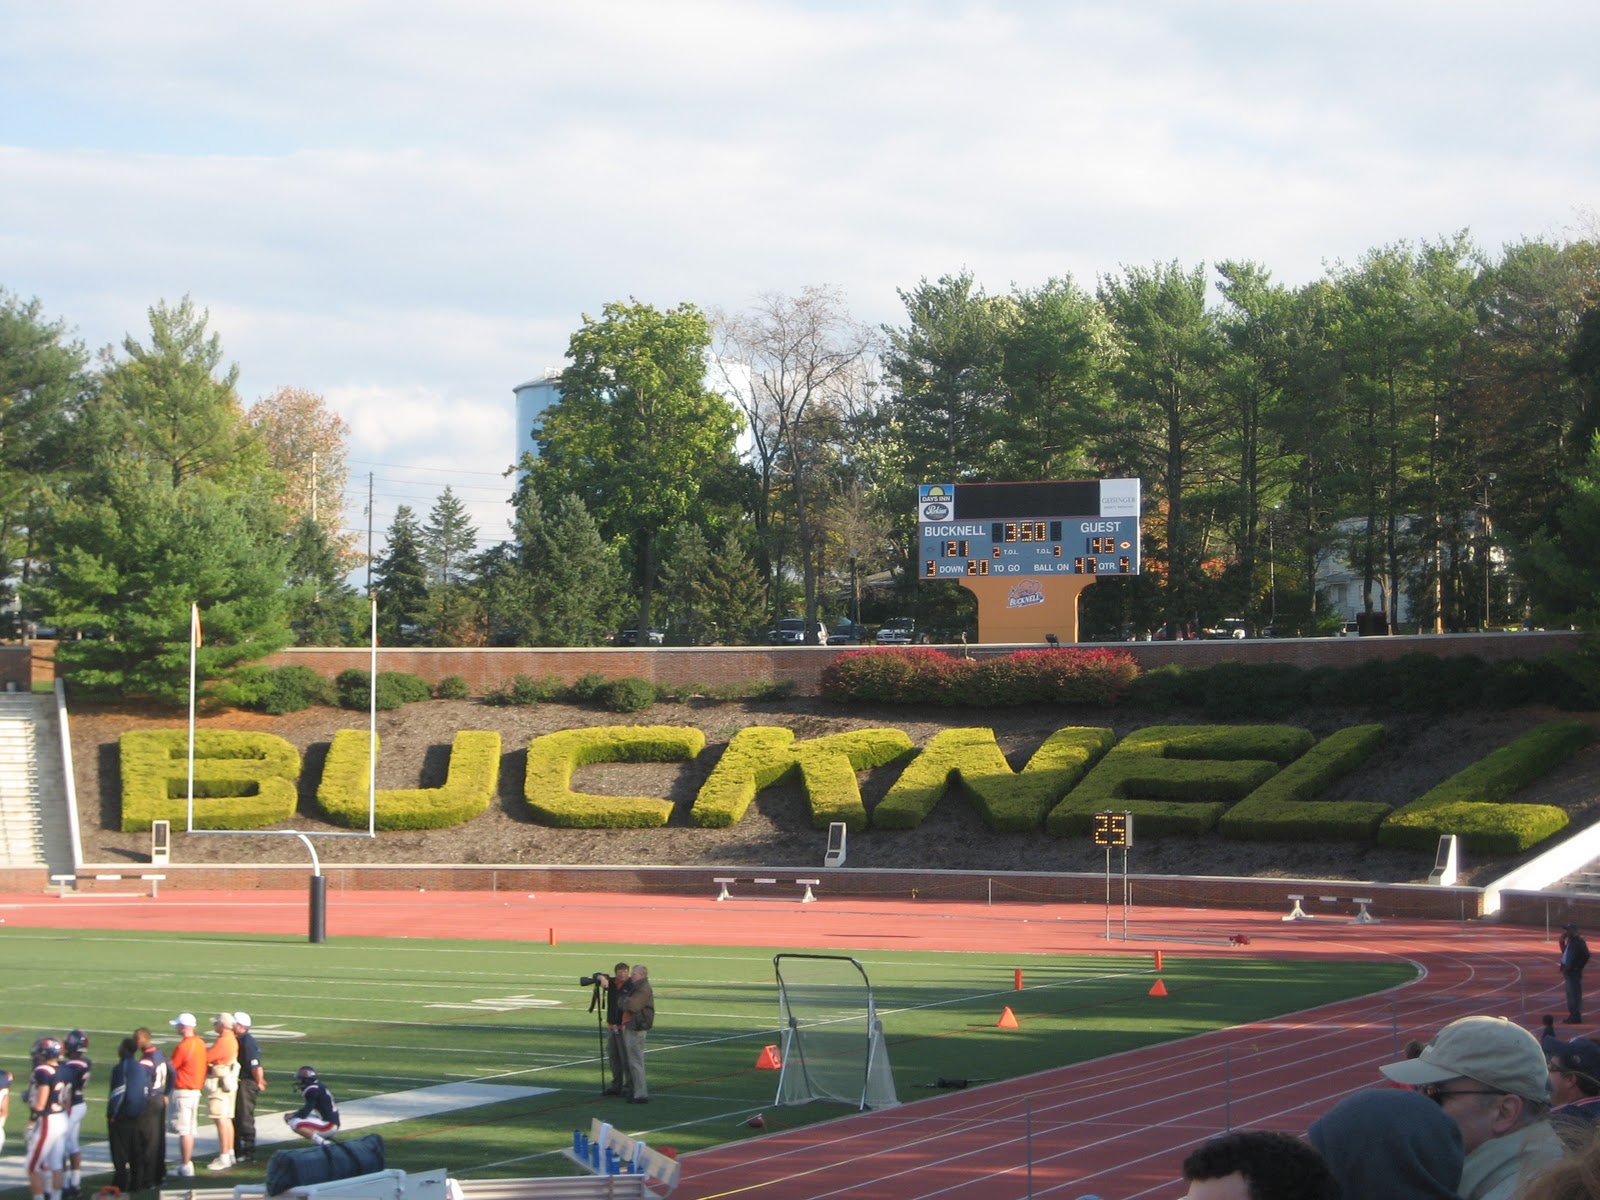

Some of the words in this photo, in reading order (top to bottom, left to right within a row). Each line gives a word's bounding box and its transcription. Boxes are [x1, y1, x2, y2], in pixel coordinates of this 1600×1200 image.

[924, 525, 986, 537] BUCKNELL
[1006, 523, 1046, 542] 3:50
[1080, 521, 1121, 533] GUEST
[947, 540, 969, 557] 21
[993, 546, 1001, 559] 2
[1054, 545, 1062, 558] 3
[1092, 536, 1115, 554] 45
[927, 560, 936, 577] 3
[939, 565, 964, 573] DOWN
[967, 559, 989, 576] 20
[994, 564, 1005, 572] TO
[1007, 564, 1020, 572] GO
[1034, 563, 1054, 571] BALL
[1057, 563, 1070, 571] ON
[1075, 557, 1097, 574] 47
[1119, 556, 1129, 573] 4
[119, 719, 1592, 853] BUCKNELL
[1095, 815, 1125, 845] 25
